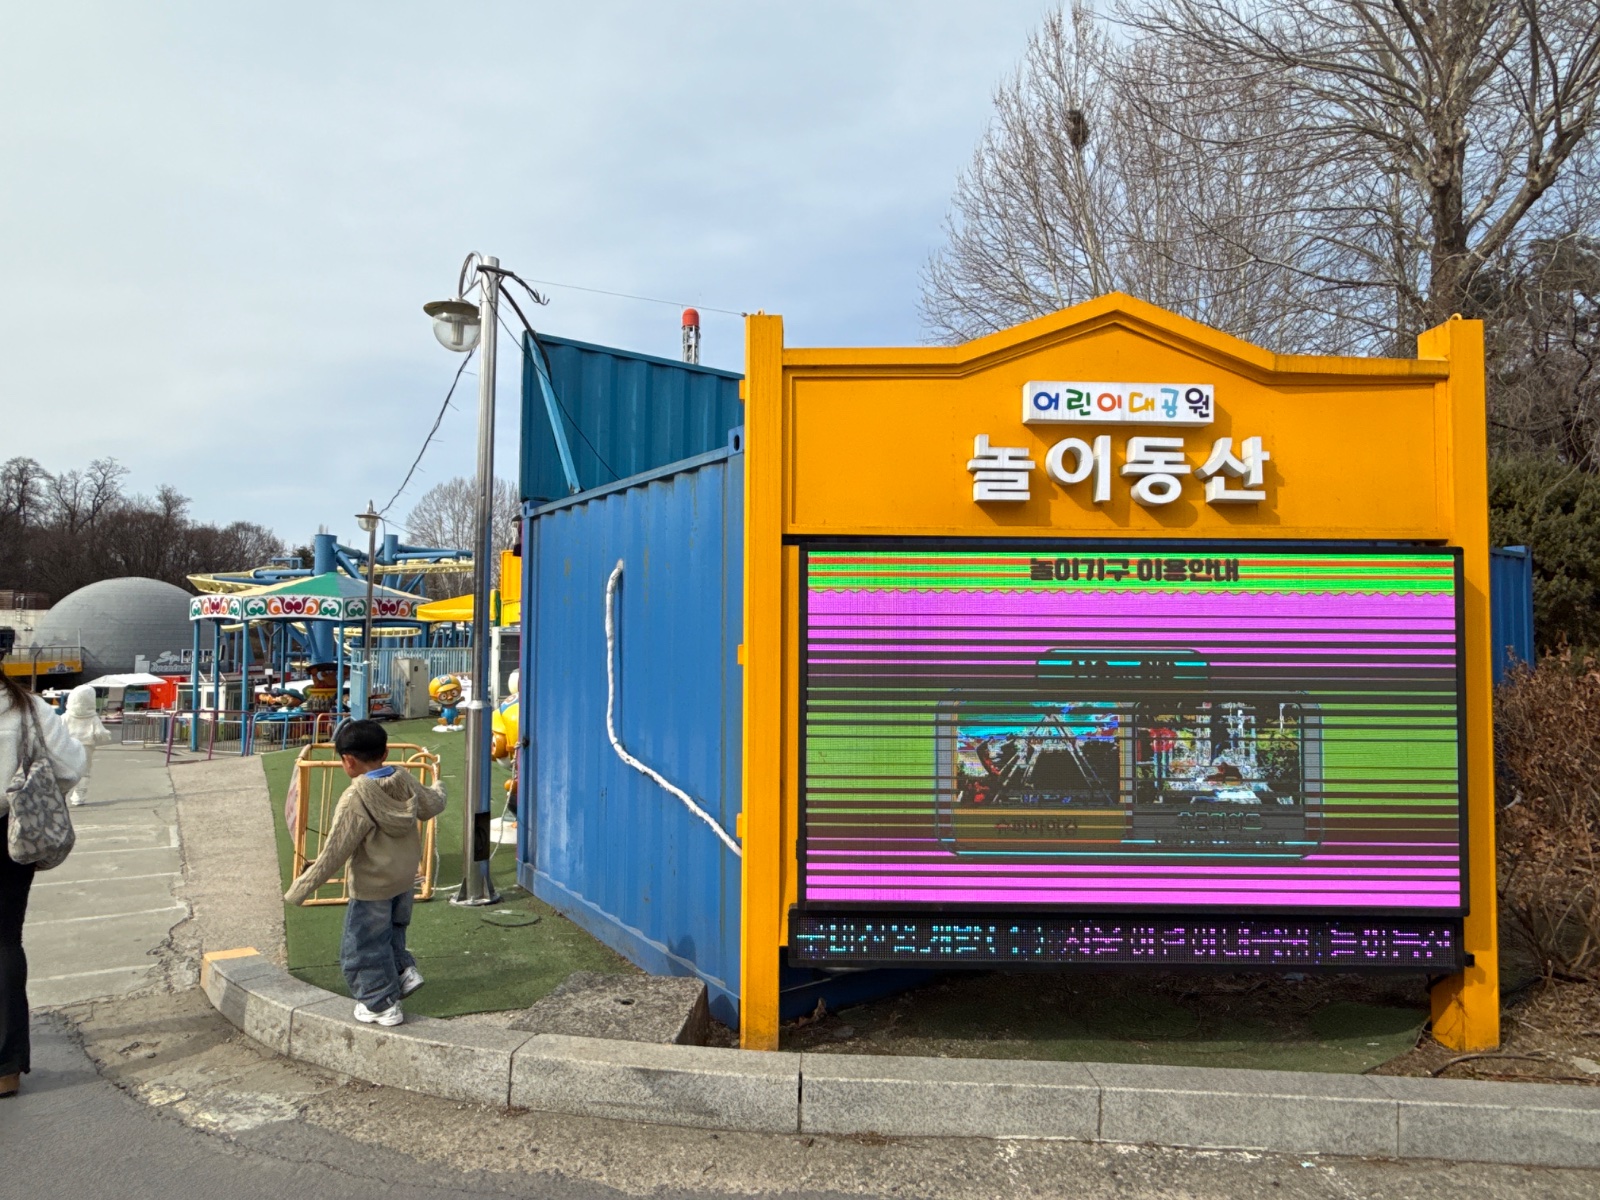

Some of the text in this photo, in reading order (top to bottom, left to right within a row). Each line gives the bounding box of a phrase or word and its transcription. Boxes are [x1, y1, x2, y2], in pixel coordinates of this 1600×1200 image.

[1033, 387, 1210, 419] 어린이대공원
[966, 433, 1270, 507] 놀이동산
[1029, 557, 1240, 583] 놀이기구 이용안내
